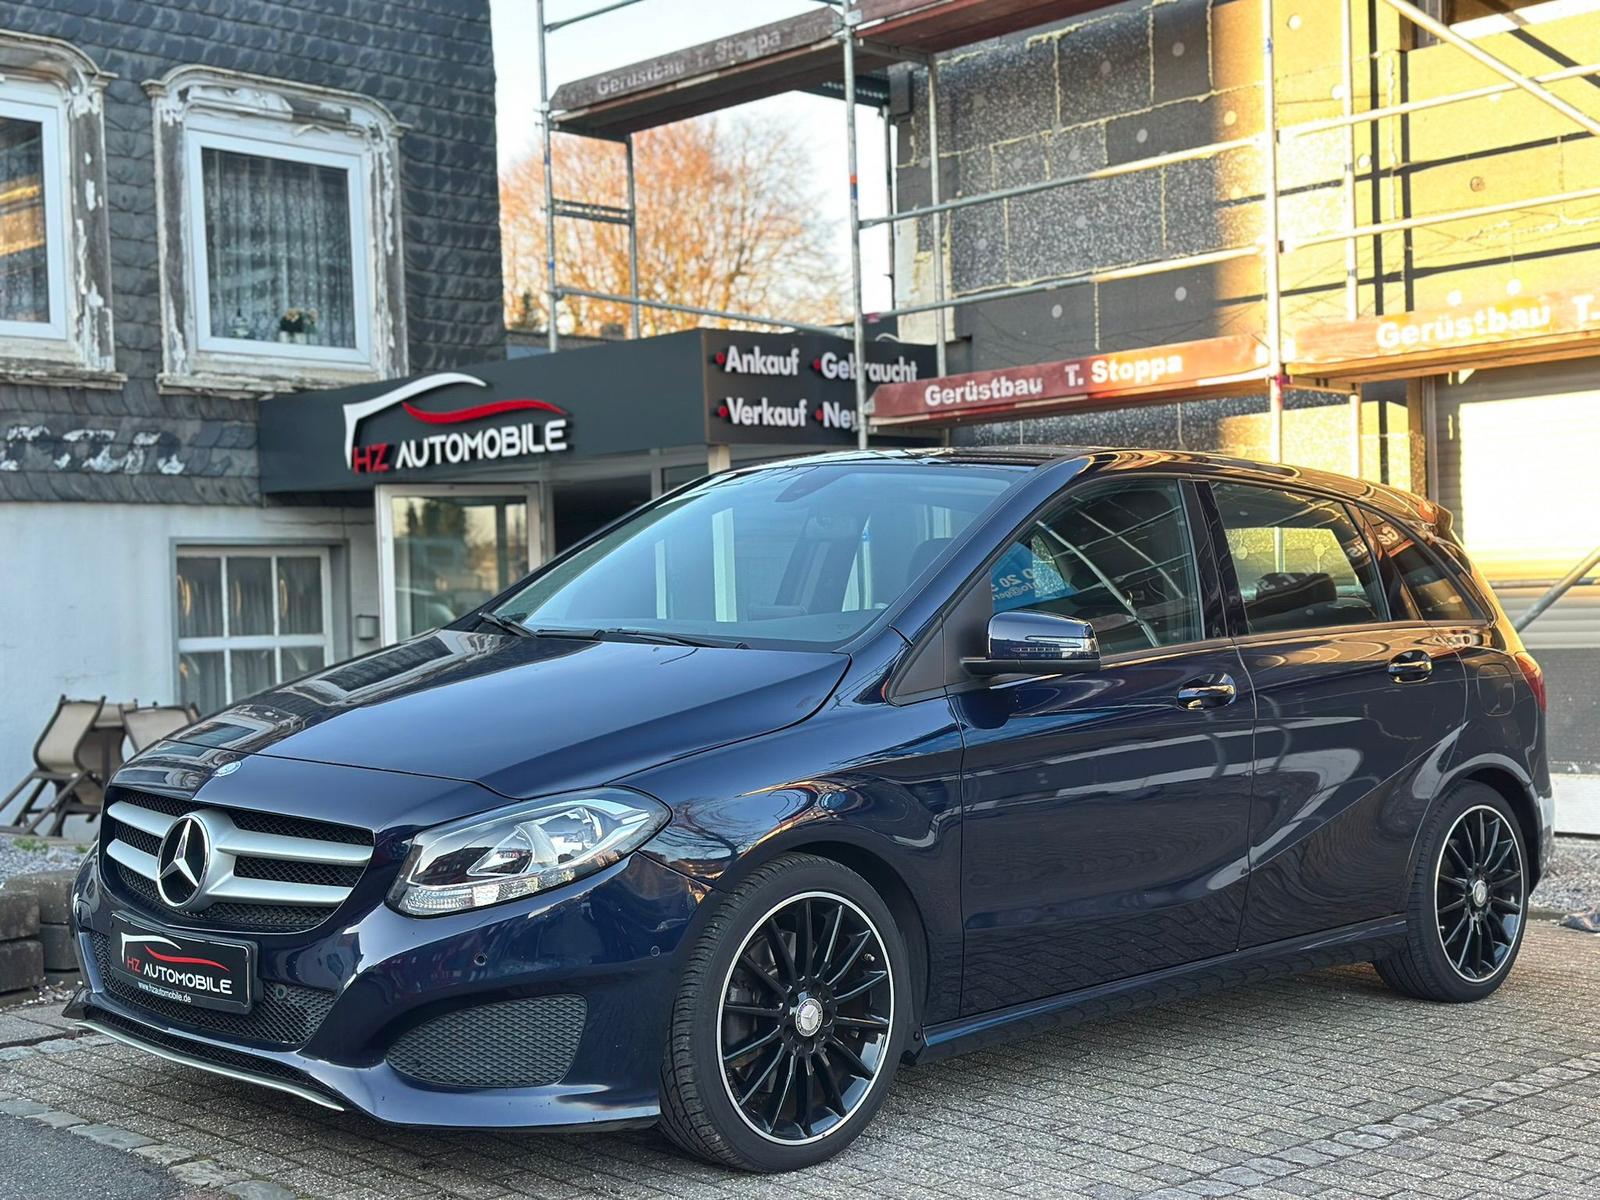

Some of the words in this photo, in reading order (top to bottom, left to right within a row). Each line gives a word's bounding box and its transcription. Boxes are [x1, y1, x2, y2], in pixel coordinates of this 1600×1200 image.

[1377, 303, 1550, 349] Gerüstbau
[725, 345, 799, 376] Ankauf
[925, 376, 1043, 406] Gerüstbau
[1065, 364, 1084, 387] T.
[1092, 354, 1183, 385] Stoppa
[727, 396, 807, 427] Verkauf
[353, 442, 389, 474] HZ
[396, 419, 567, 469] AUTOMOBILE
[126, 955, 141, 973] HZ
[143, 963, 233, 995] AUTOMOBILE
[137, 981, 192, 1003] www.hzautomobile.de
